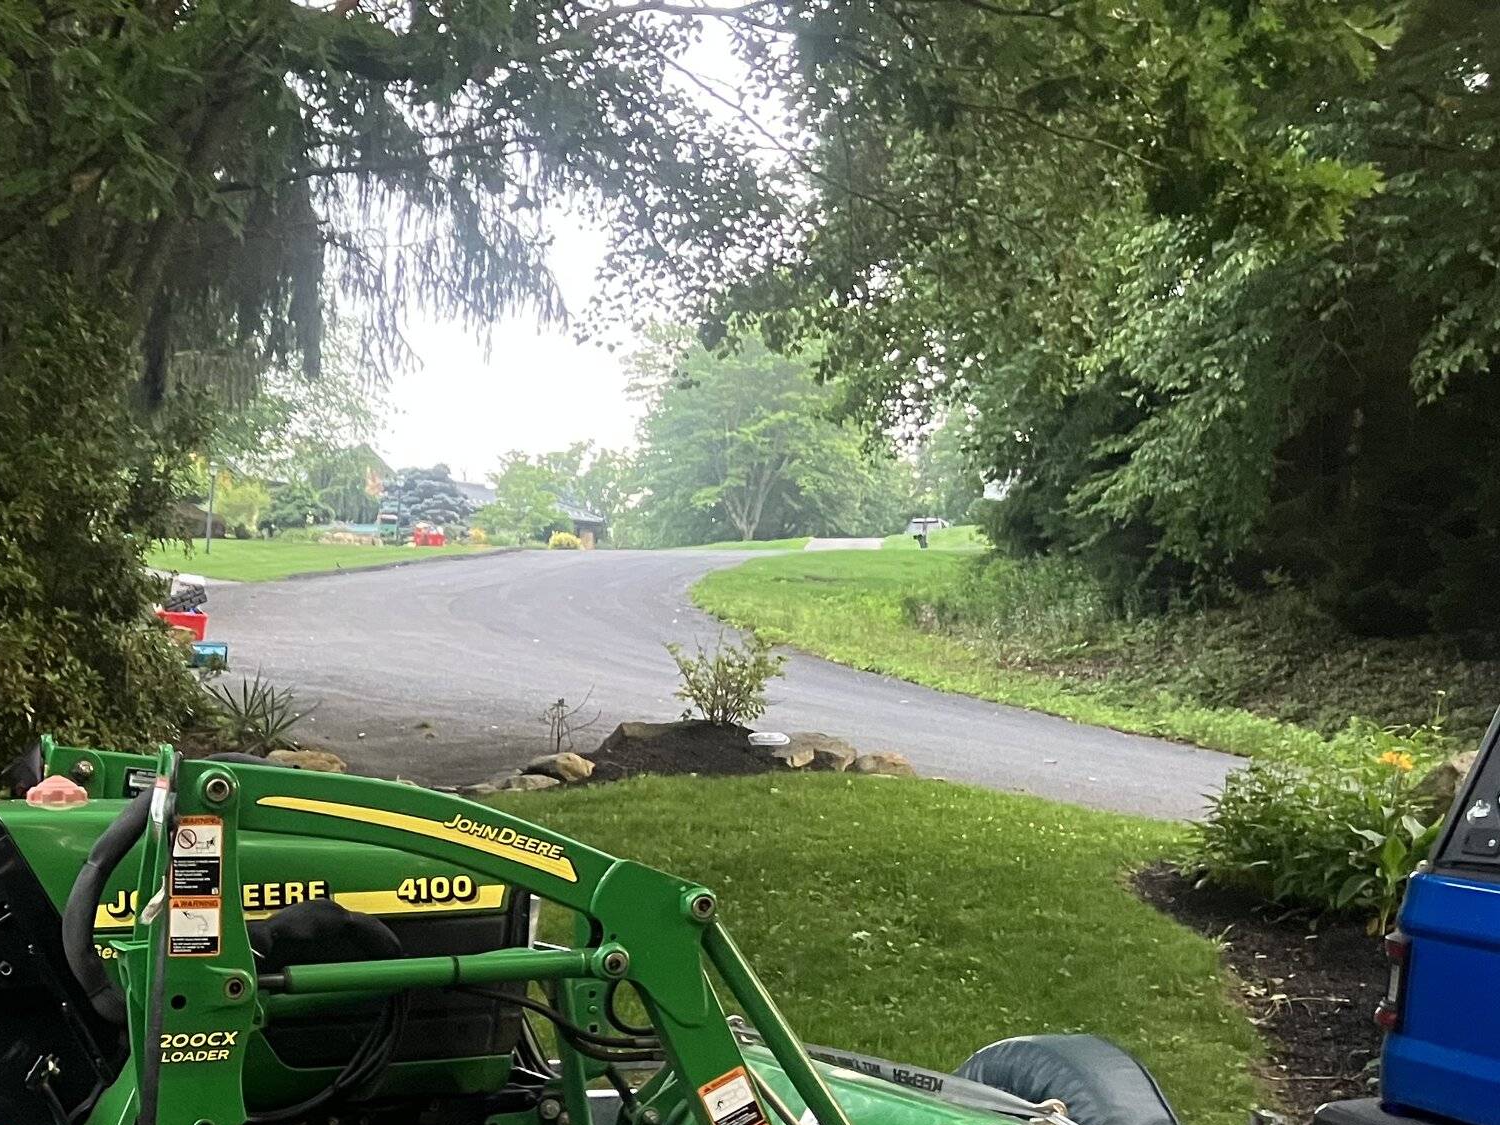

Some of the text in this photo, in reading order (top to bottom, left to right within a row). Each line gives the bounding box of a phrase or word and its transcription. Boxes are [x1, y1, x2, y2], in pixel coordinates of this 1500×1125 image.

[443, 813, 564, 860] JOHN DEERE
[242, 879, 326, 908] EERE
[397, 874, 475, 902] 4100
[181, 899, 219, 908] WARNING
[160, 1030, 239, 1048] 200CX
[161, 1049, 230, 1063] LOADER
[892, 1067, 944, 1093] KEEPER
